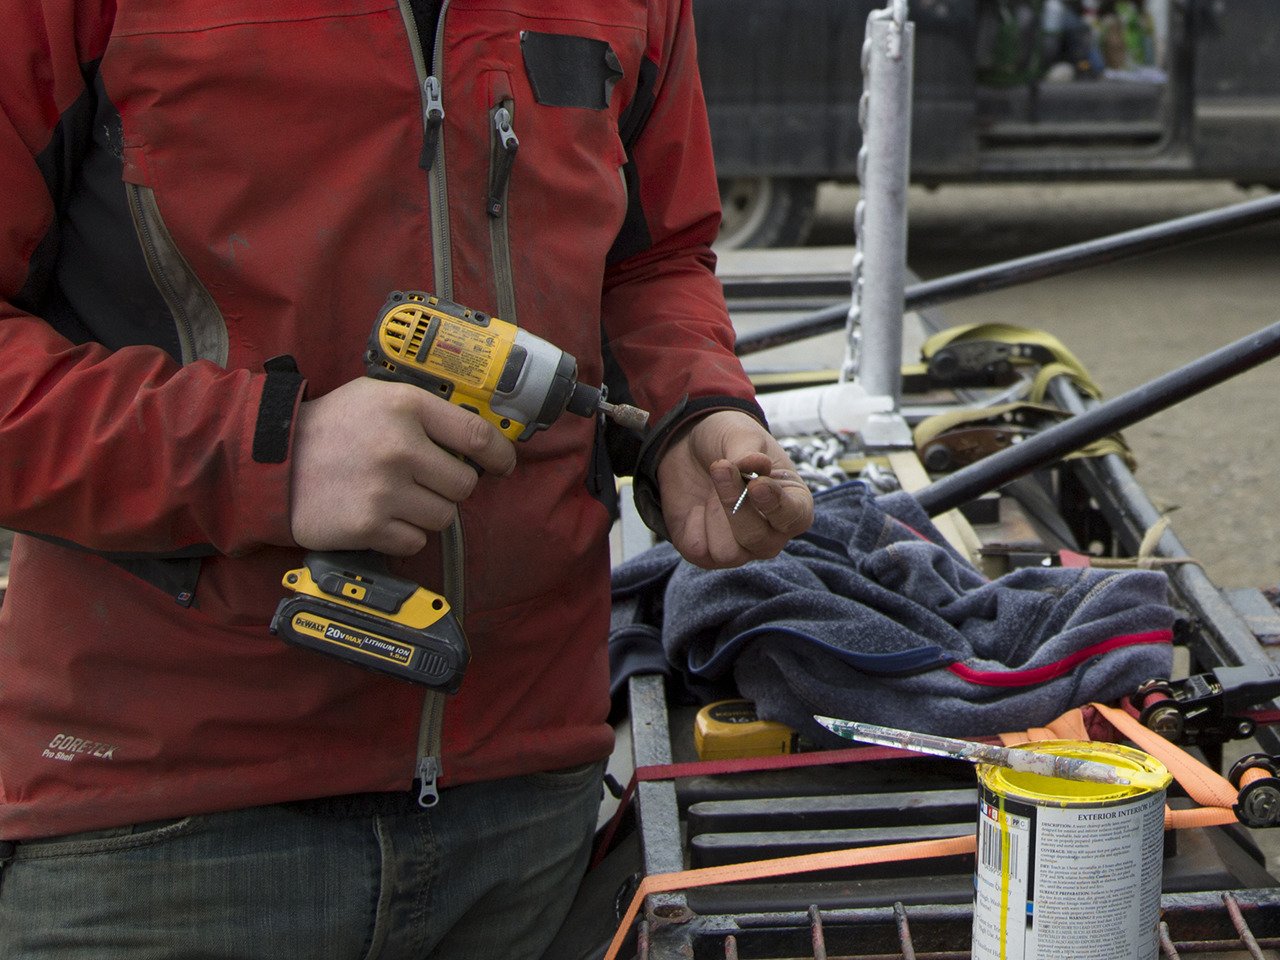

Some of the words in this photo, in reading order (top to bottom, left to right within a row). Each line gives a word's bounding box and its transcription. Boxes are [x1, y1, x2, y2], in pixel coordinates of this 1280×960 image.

[365, 637, 394, 651] LITHIUM
[395, 646, 411, 657] ION
[42, 749, 55, 758] Pro
[55, 751, 75, 762] Shell
[1078, 811, 1117, 821] EXTERIOR
[1118, 804, 1148, 817] INTERIOR
